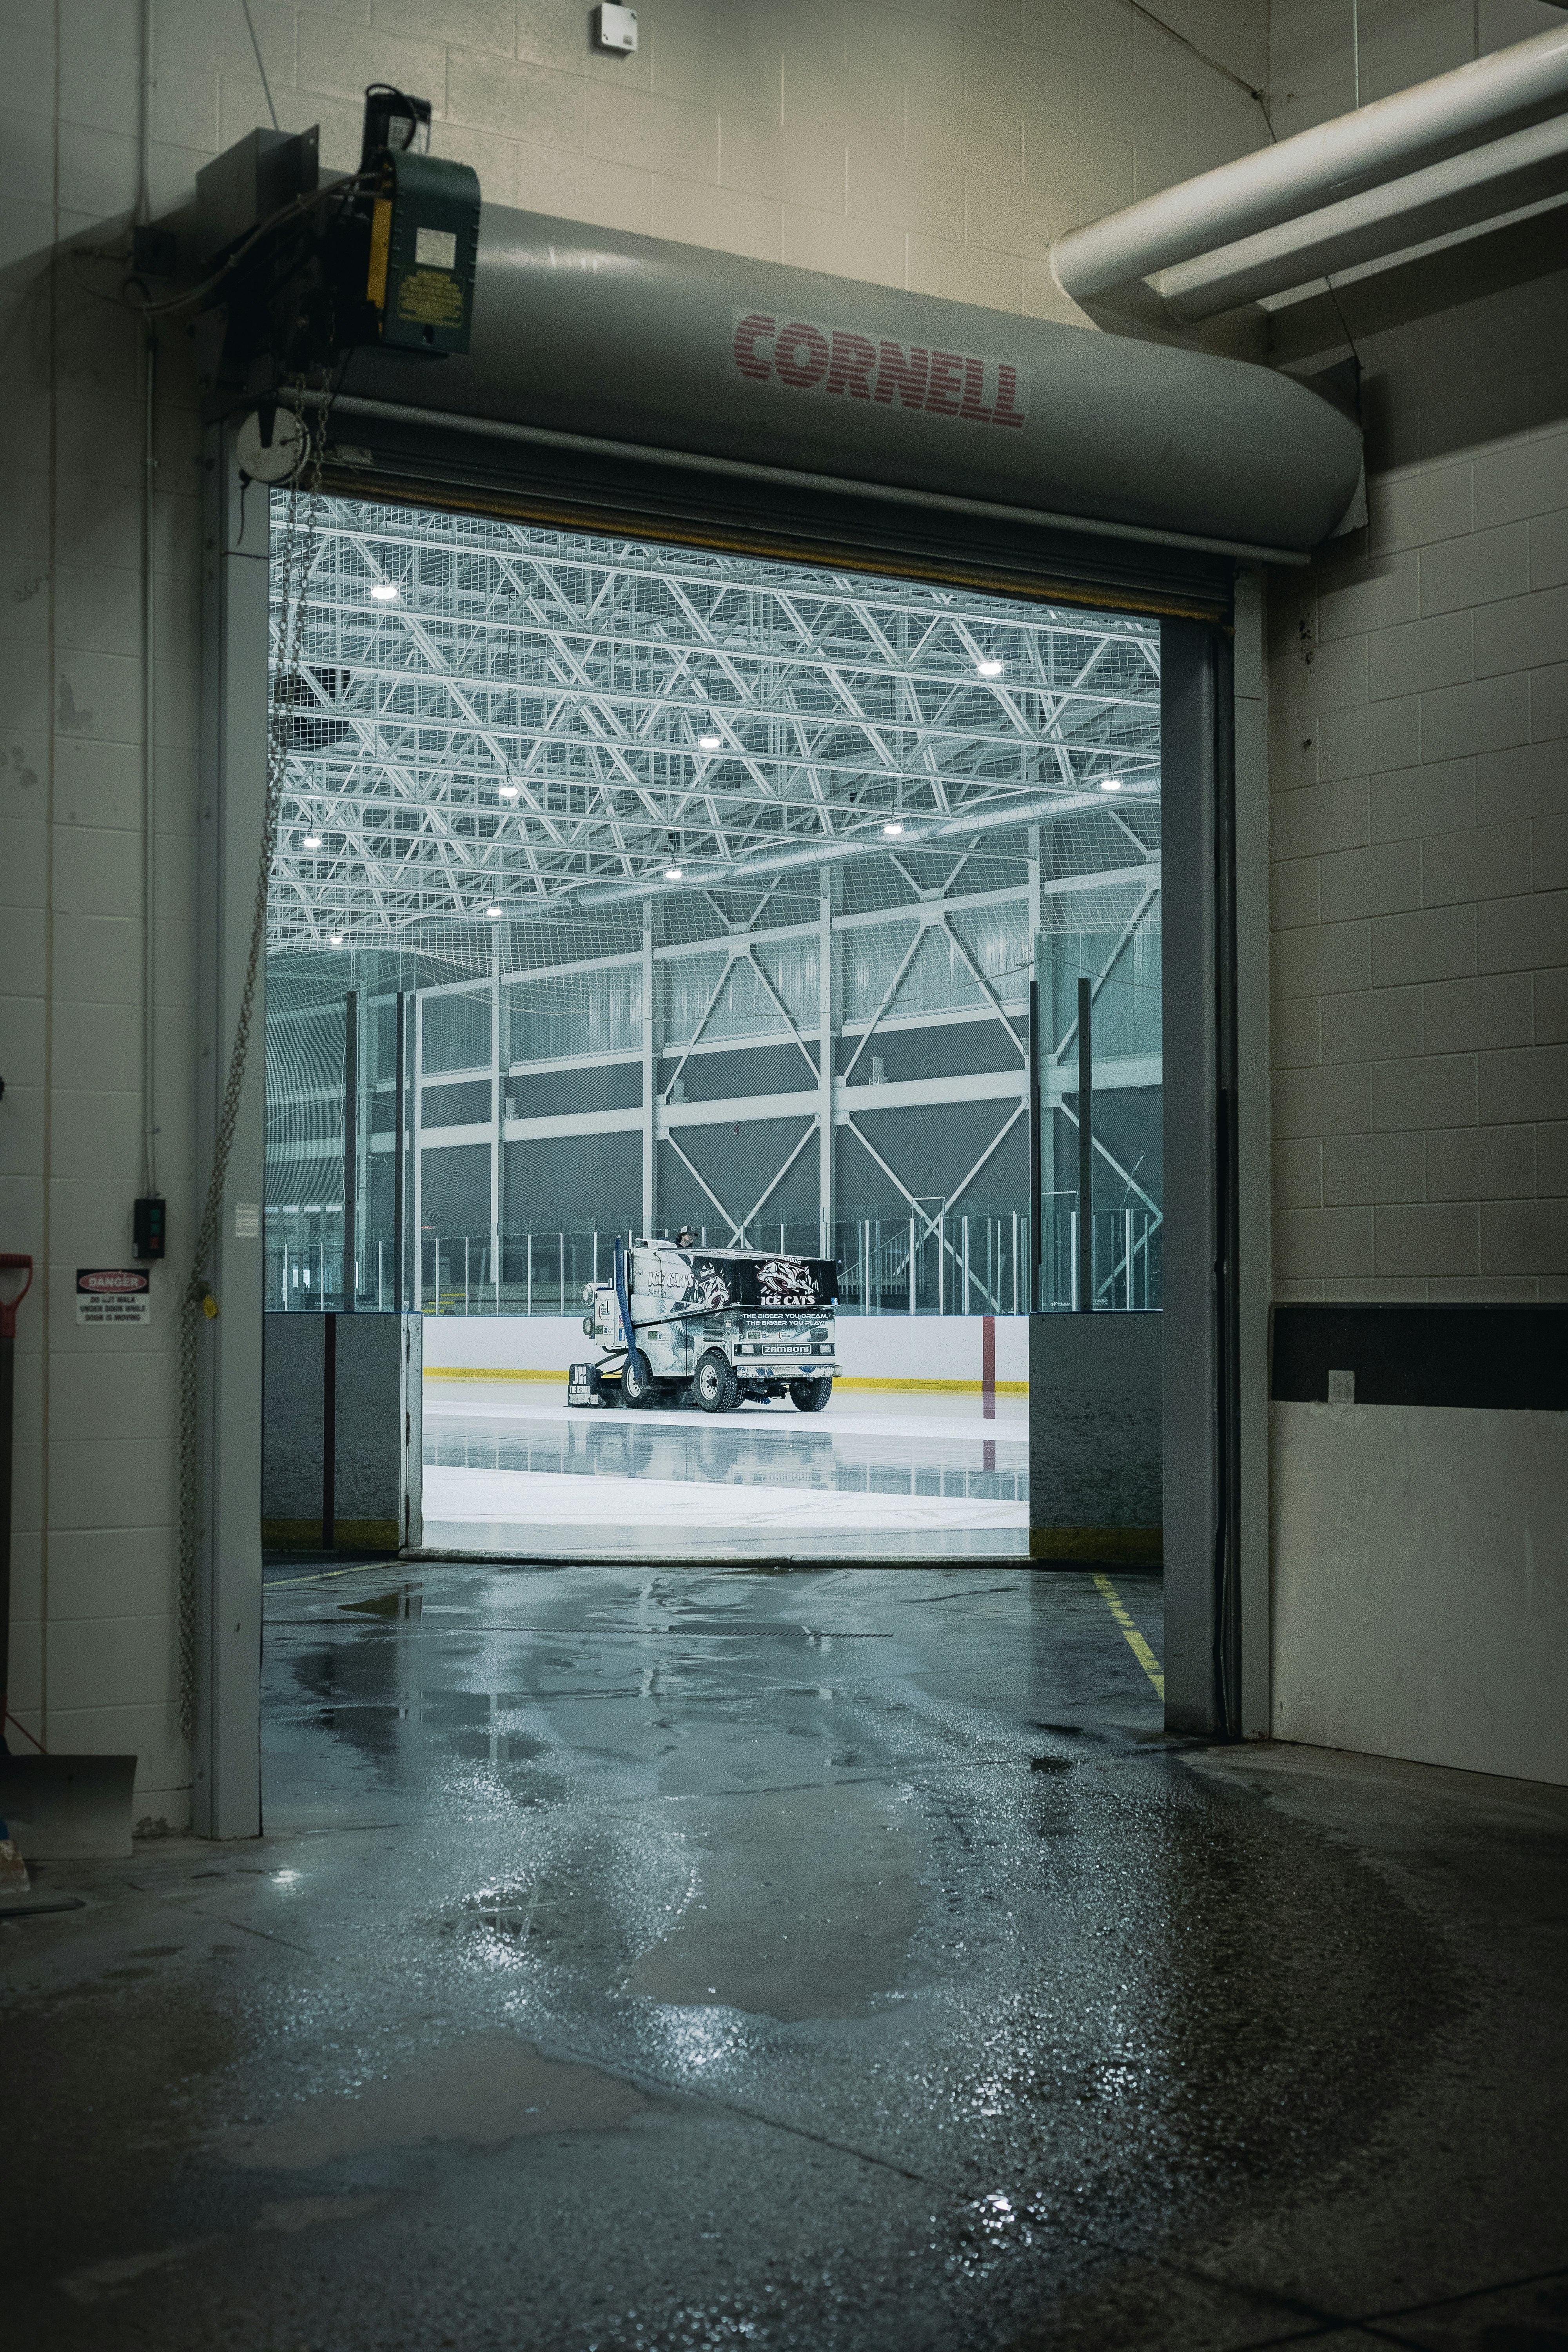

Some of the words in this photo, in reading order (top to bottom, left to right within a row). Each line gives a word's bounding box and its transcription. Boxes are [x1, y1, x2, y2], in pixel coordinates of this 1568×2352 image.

[734, 314, 1025, 428] CORNELL
[89, 1277, 139, 1287] DANGER
[648, 1271, 666, 1287] ICE
[667, 1273, 694, 1288] CATS
[761, 1296, 781, 1305] ICE
[783, 1295, 815, 1305] CATS
[577, 1385, 590, 1394] ICEMAN
